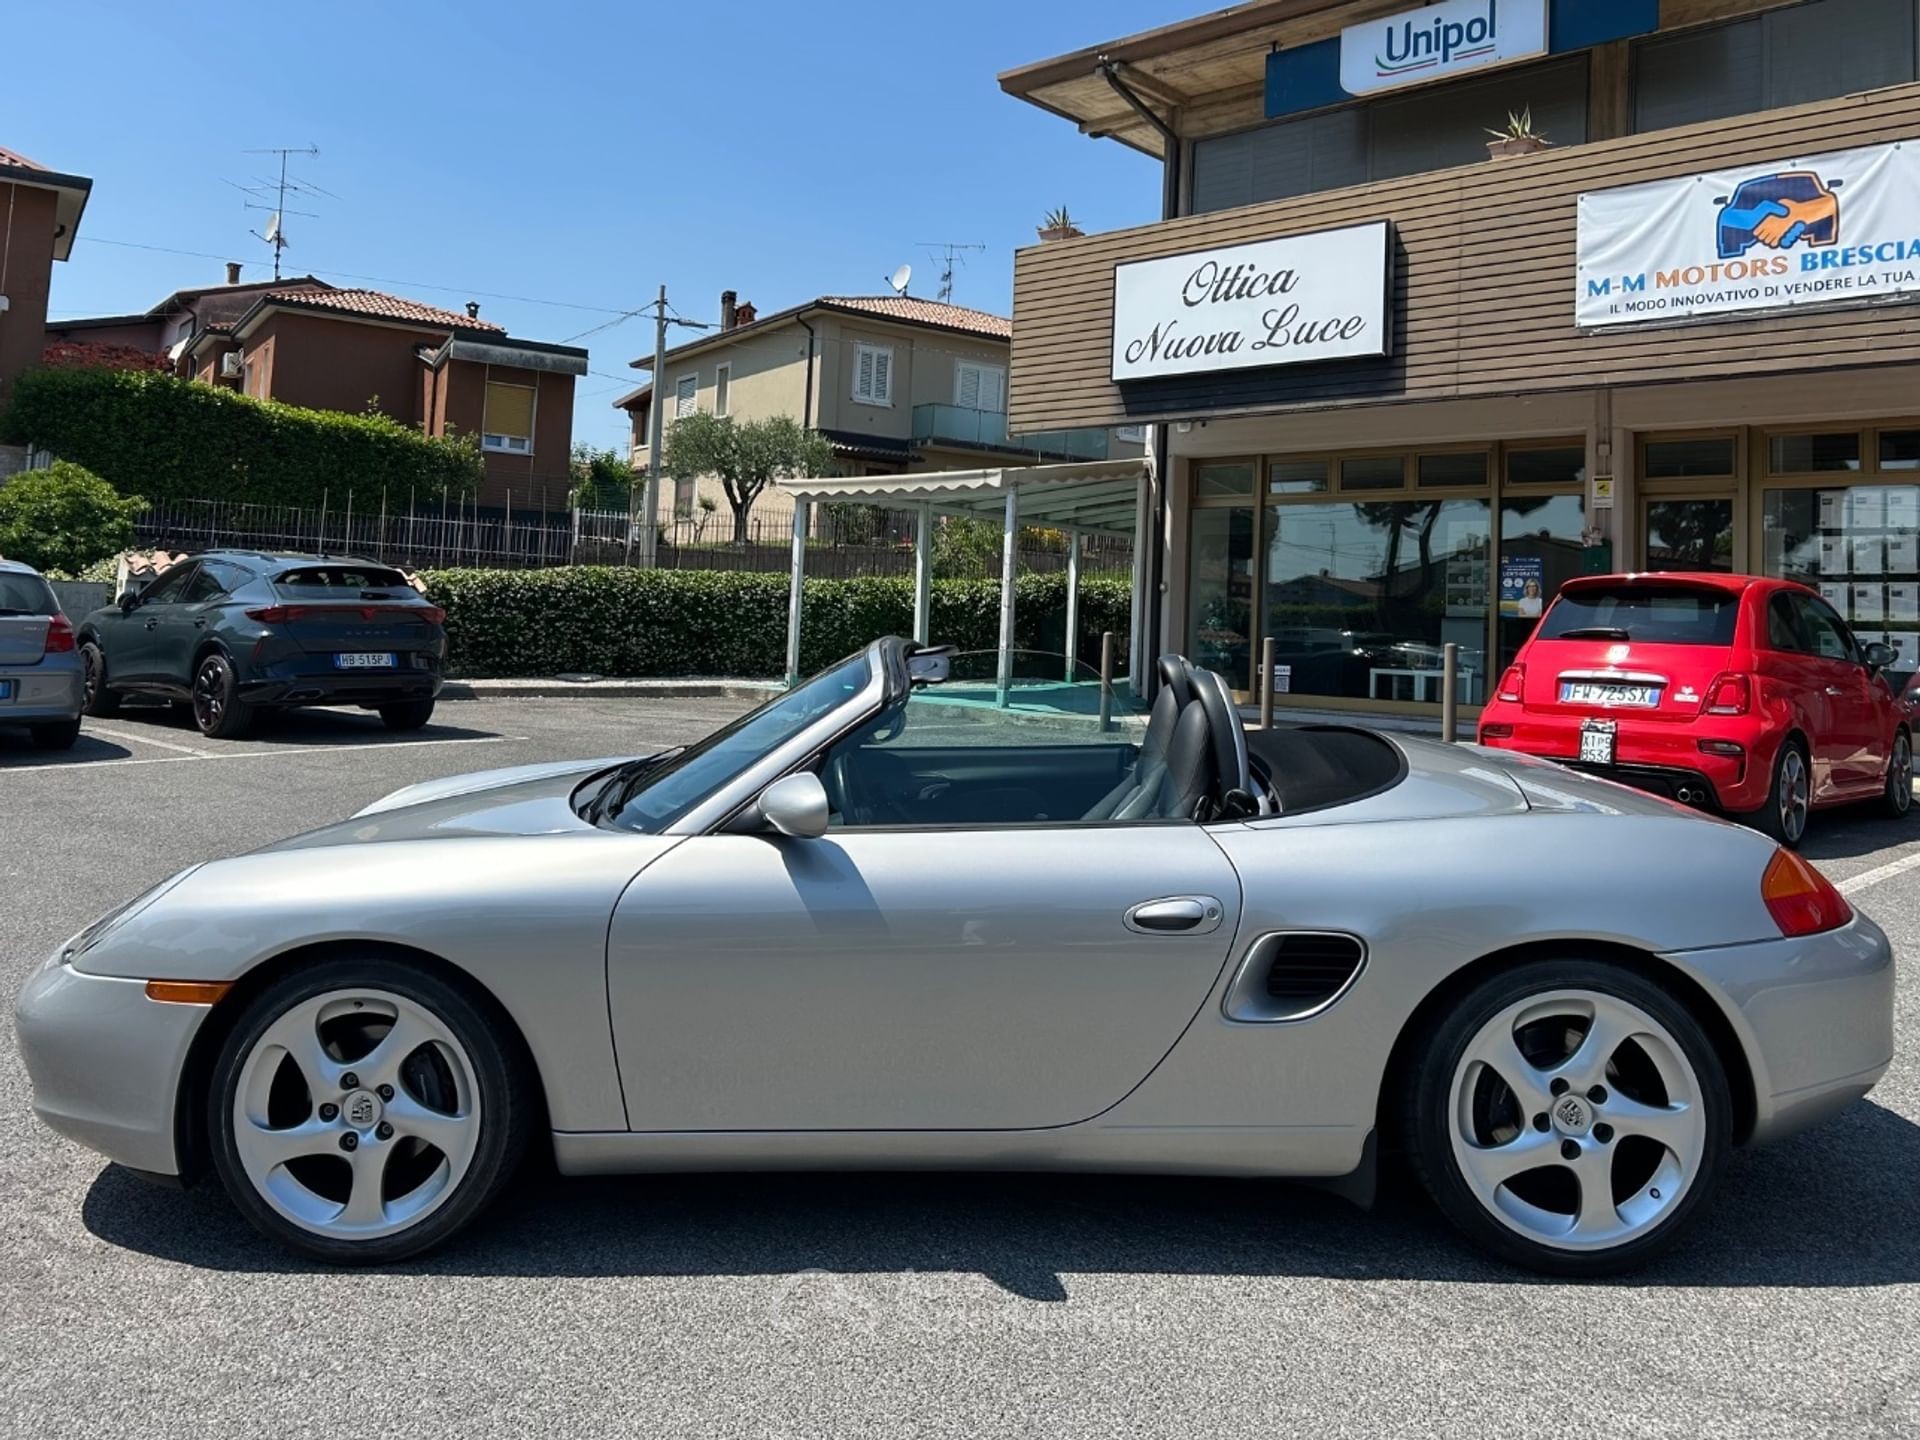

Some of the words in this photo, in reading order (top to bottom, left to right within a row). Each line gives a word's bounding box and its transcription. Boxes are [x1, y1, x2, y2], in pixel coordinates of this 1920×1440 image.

[1386, 0, 1496, 63] Unipol
[1182, 260, 1299, 307] Ottica
[1588, 273, 1646, 297] M-M
[1655, 255, 1788, 290] MOTORS
[1610, 304, 1620, 314] IL
[1625, 298, 1666, 313] MODO
[1671, 287, 1759, 307] INNOVATIVO
[1764, 285, 1779, 297] DI
[1784, 277, 1852, 294] VENDERE
[1858, 274, 1877, 286] LA
[1882, 270, 1915, 284] TUA
[1125, 319, 1245, 364] Nuova
[1251, 303, 1366, 350] Luce
[1572, 684, 1592, 699] FW
[1597, 685, 1649, 702] 725SX
